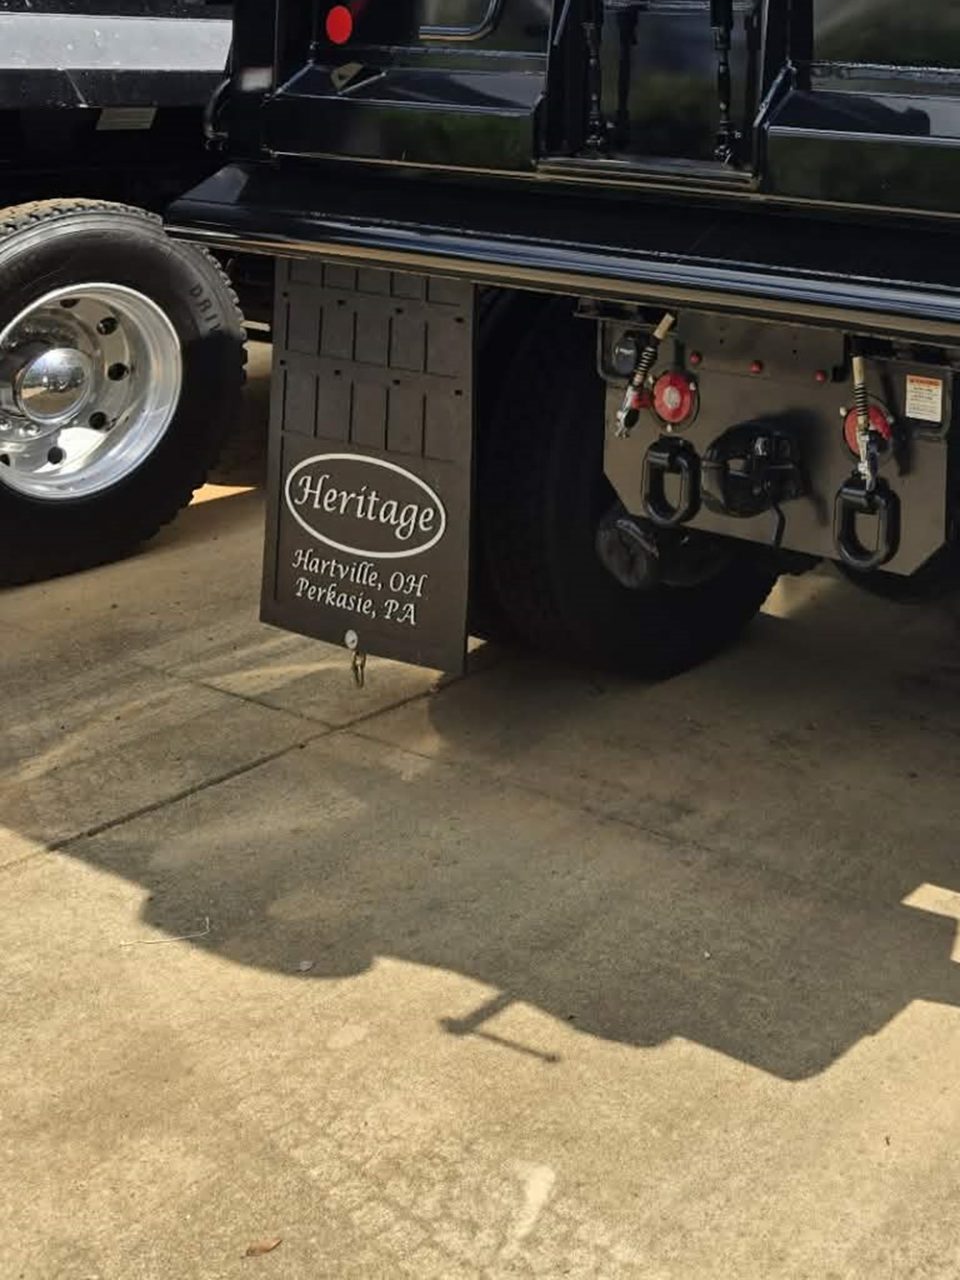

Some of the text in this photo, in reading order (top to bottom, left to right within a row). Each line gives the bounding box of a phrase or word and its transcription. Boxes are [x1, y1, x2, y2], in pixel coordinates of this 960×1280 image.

[294, 474, 434, 540] Heritage
[292, 548, 428, 597] Hartville, OH
[295, 577, 417, 625] Perkasie, PA
